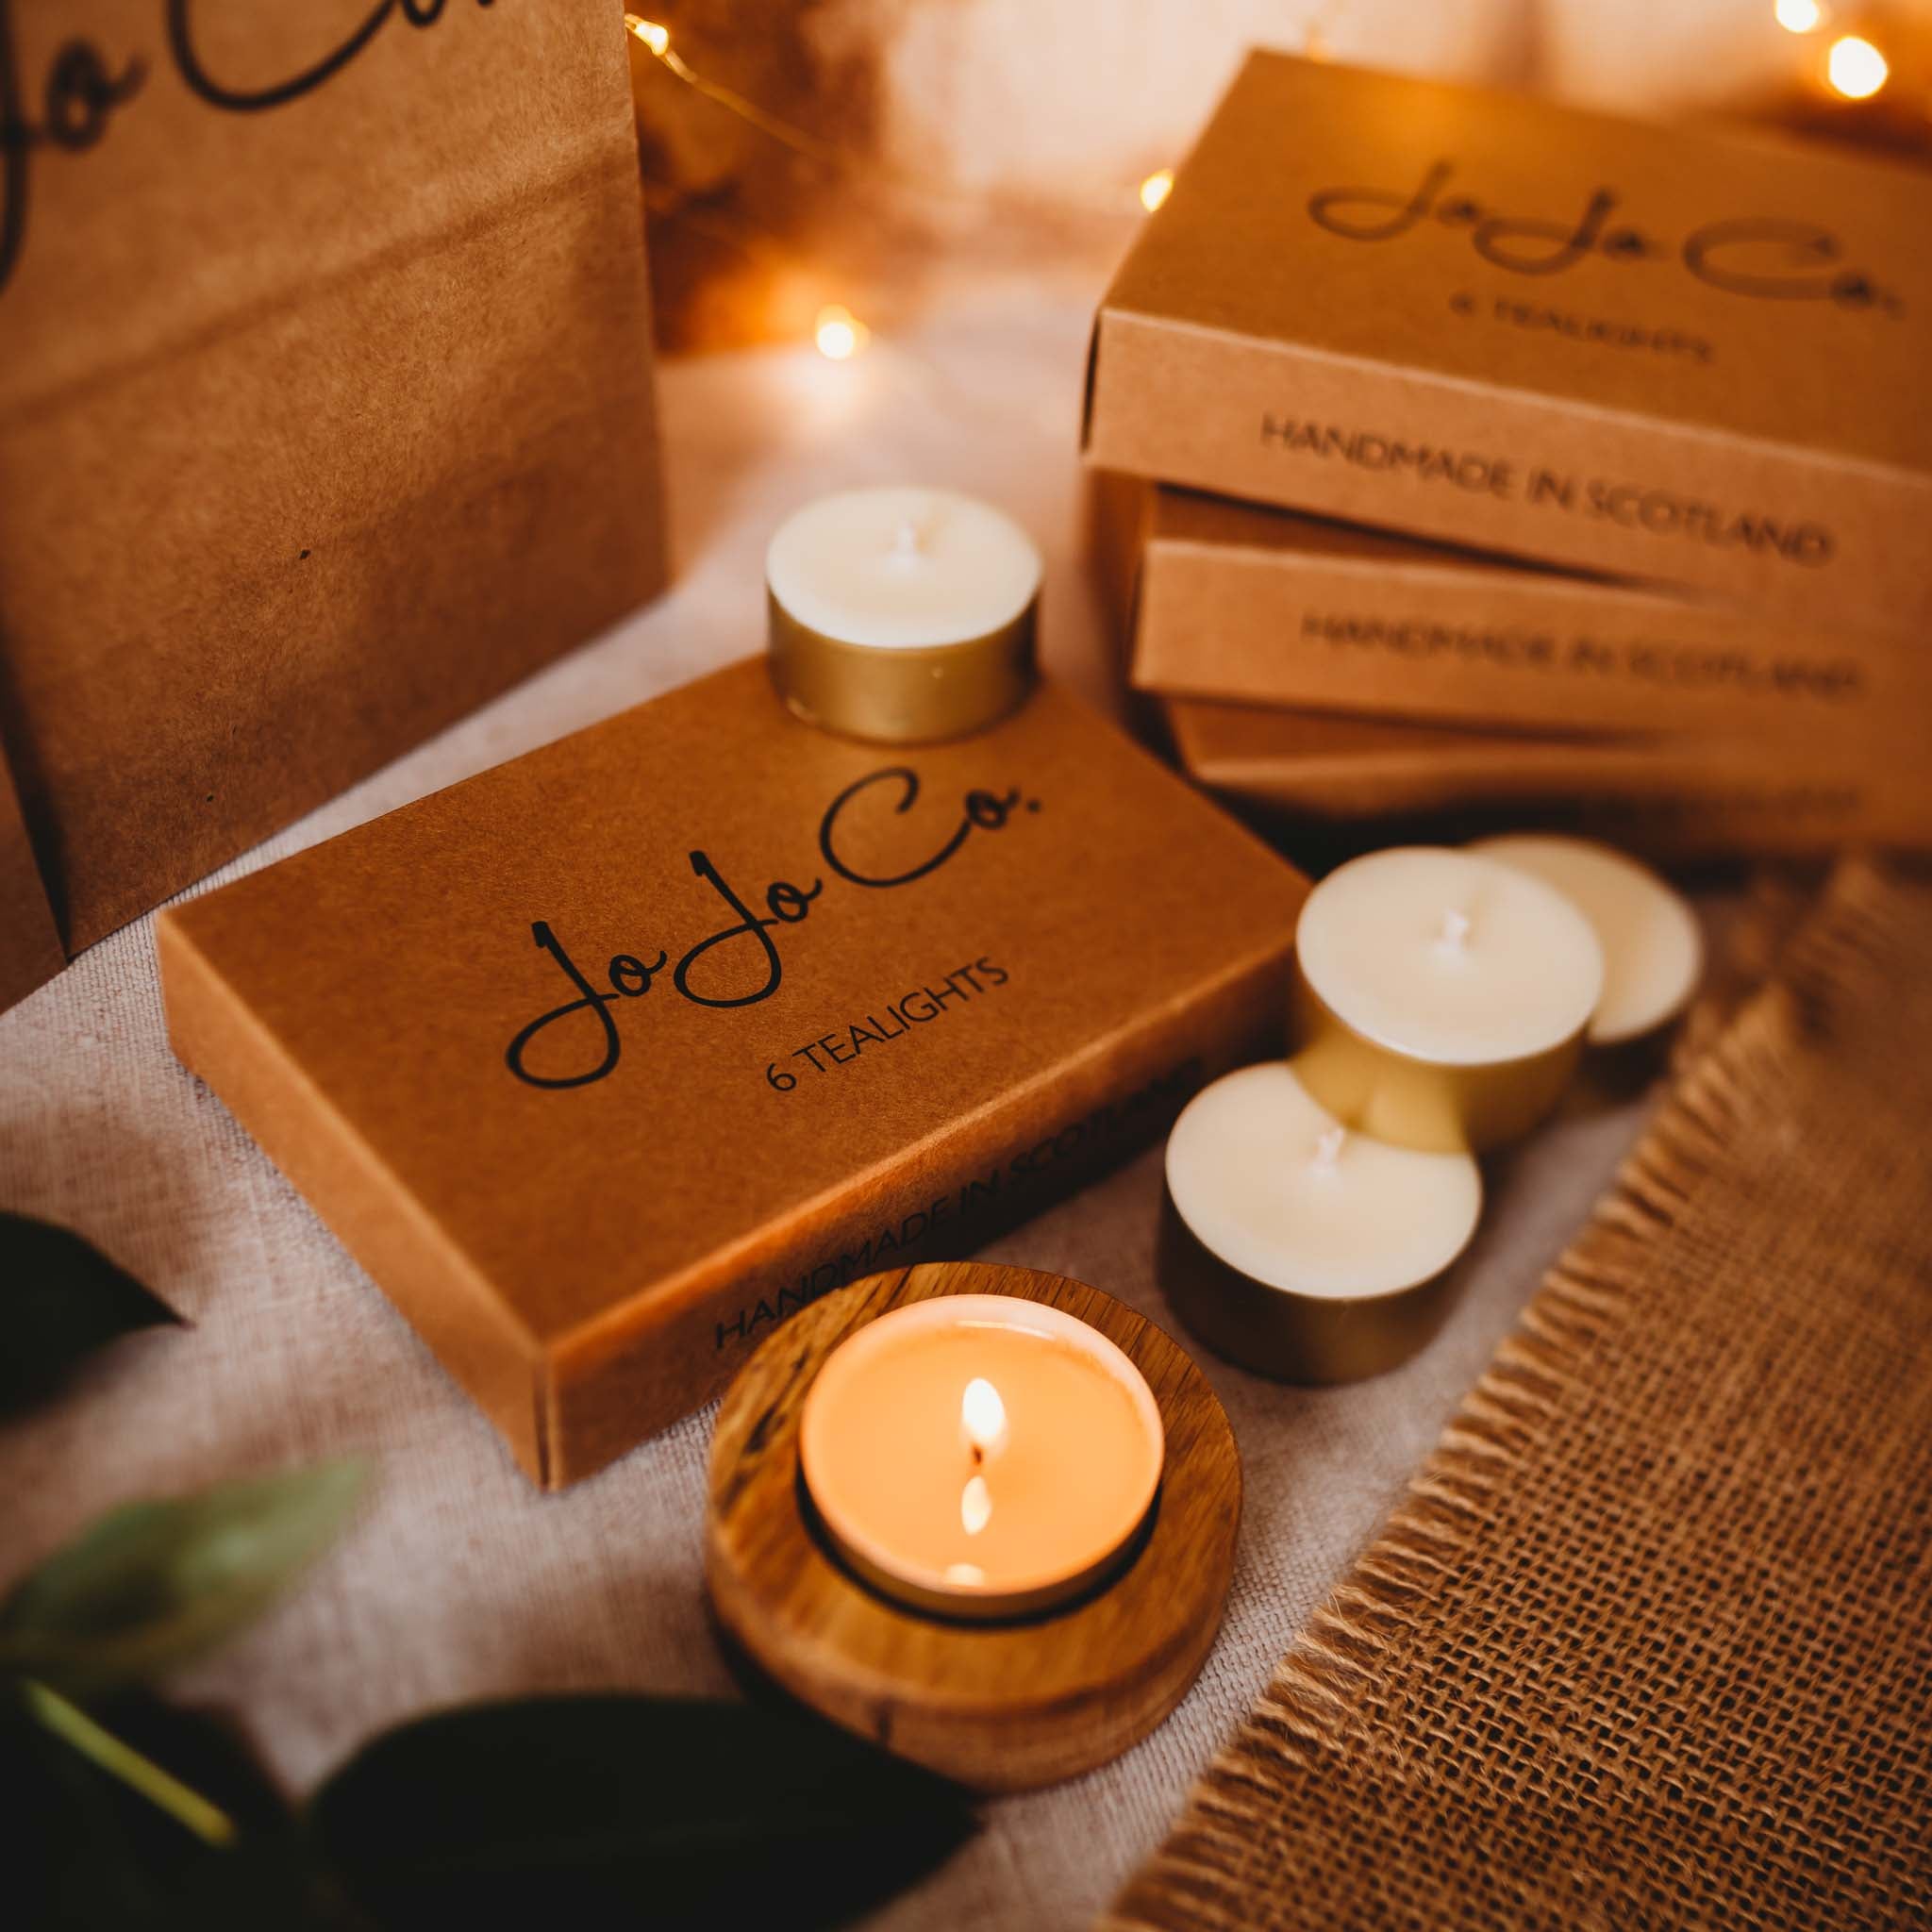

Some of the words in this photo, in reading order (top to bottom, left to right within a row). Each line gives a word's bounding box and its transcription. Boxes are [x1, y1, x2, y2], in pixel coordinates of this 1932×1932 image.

[1259, 411, 1514, 501] HANDMADE
[1525, 466, 1578, 512] IN
[1585, 475, 1838, 566] SCOTLAND
[820, 766, 1042, 889] Co.
[766, 1062, 798, 1092] 6
[792, 957, 1009, 1074] TEALIGHTS
[715, 1195, 949, 1350] HANDMADE
[958, 1168, 1000, 1216] IN
